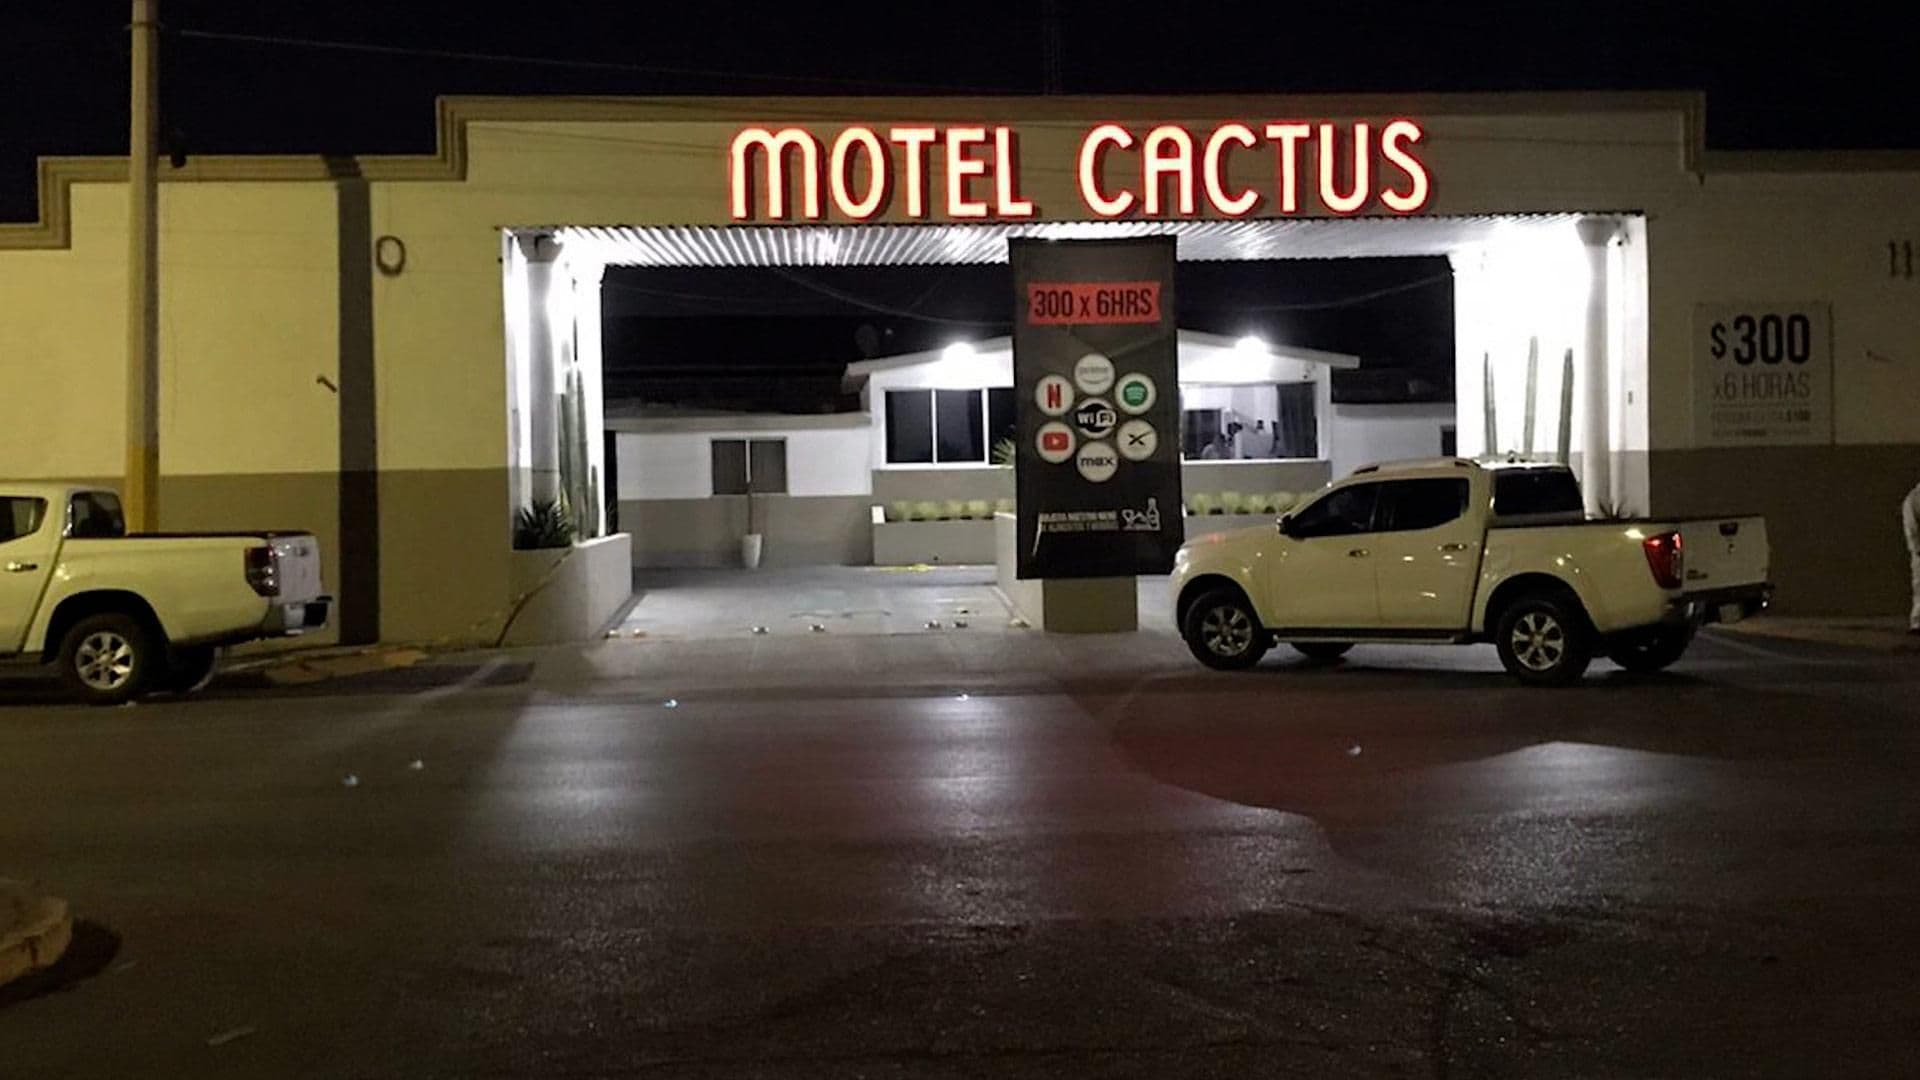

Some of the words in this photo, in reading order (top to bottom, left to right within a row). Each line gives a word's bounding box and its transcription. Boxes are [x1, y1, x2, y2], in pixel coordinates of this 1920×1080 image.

[730, 126, 1034, 221] MOTEL
[1078, 119, 1431, 217] CACTUS
[1034, 290, 1073, 317] 300
[1097, 288, 1153, 316] 6HRS
[1711, 314, 1810, 365] $300
[1743, 371, 1811, 399] HORAS
